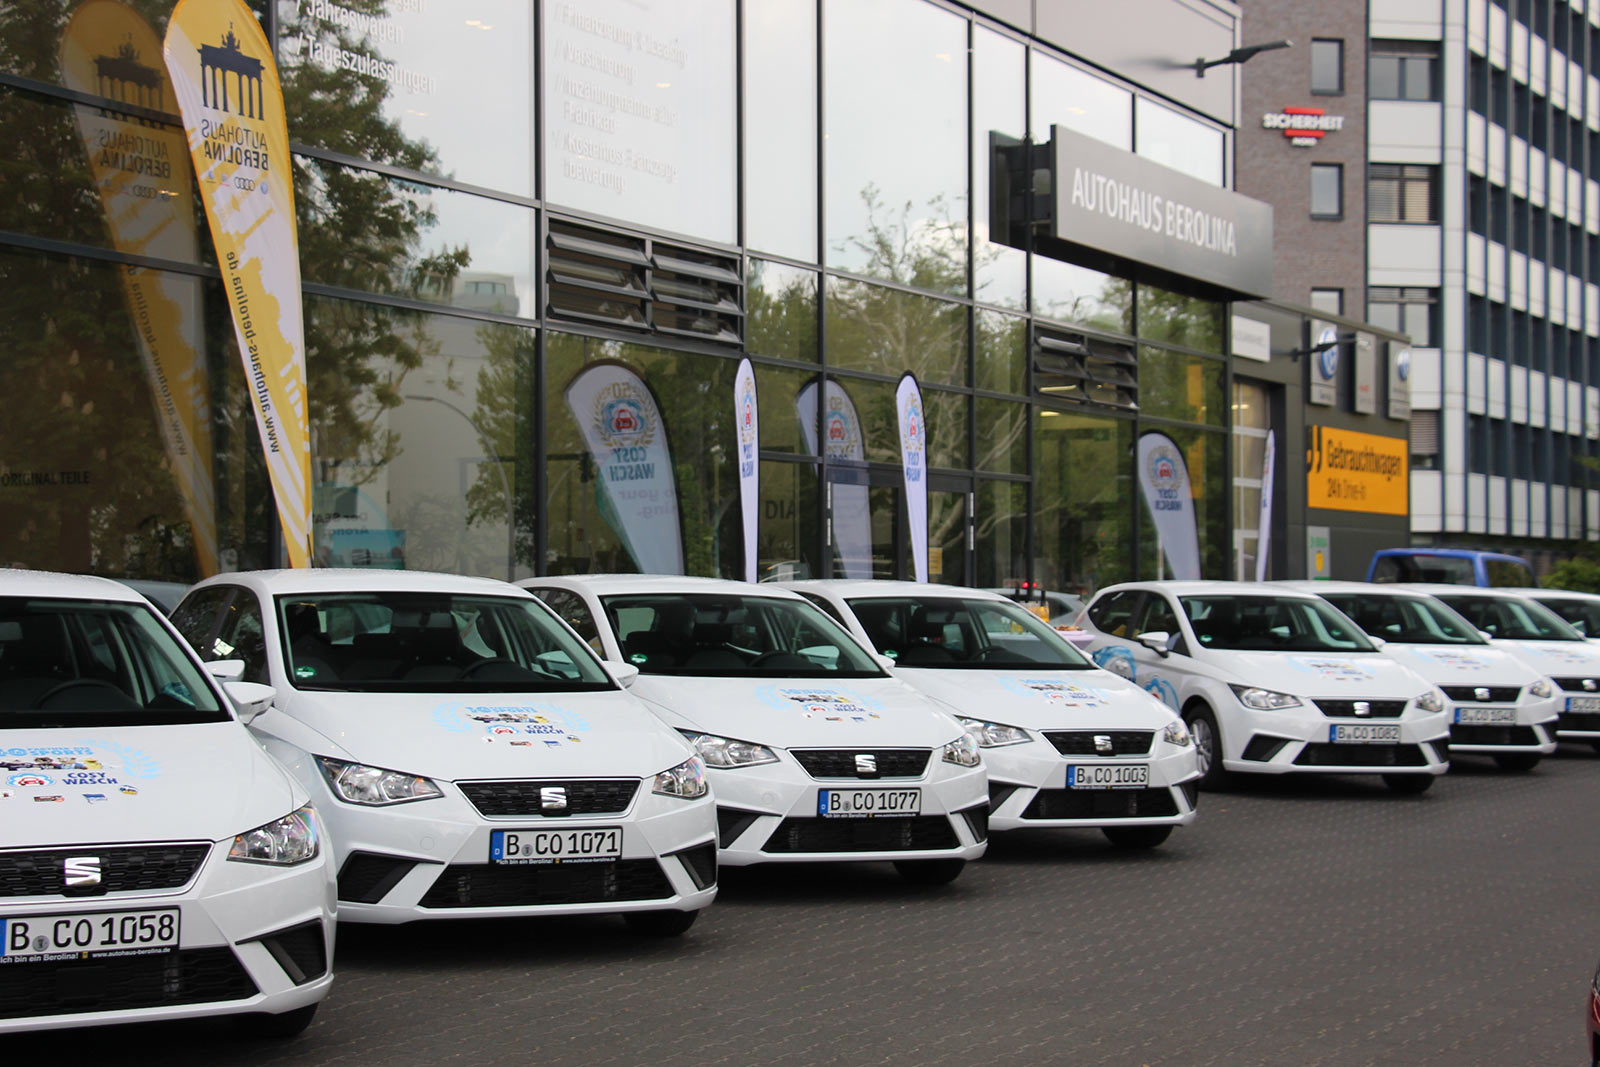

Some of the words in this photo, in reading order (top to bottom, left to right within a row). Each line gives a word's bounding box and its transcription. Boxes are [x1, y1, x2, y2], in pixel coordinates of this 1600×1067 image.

[306, 0, 404, 43] Jahreswagen
[306, 35, 437, 94] Tageszulassungen
[1263, 113, 1344, 131] SICHERHEIT
[1072, 167, 1163, 233] AUTOHAUS
[1166, 201, 1237, 257] BEROLINA
[1338, 727, 1346, 739] B
[1077, 768, 1085, 783] B
[1095, 768, 1112, 783] CO
[1115, 768, 1147, 783] 1003
[830, 793, 841, 811] B
[853, 793, 874, 810] CO
[878, 792, 918, 810] 1077
[506, 834, 520, 856] B
[536, 834, 562, 855] CO
[567, 831, 618, 854] 1071
[10, 922, 30, 951] B
[53, 919, 93, 948] CO
[100, 914, 174, 946] 1058
[14, 955, 27, 963] bin
[43, 953, 79, 961] Berolina!
[92, 947, 171, 958] www.autohaus-berolina.de
